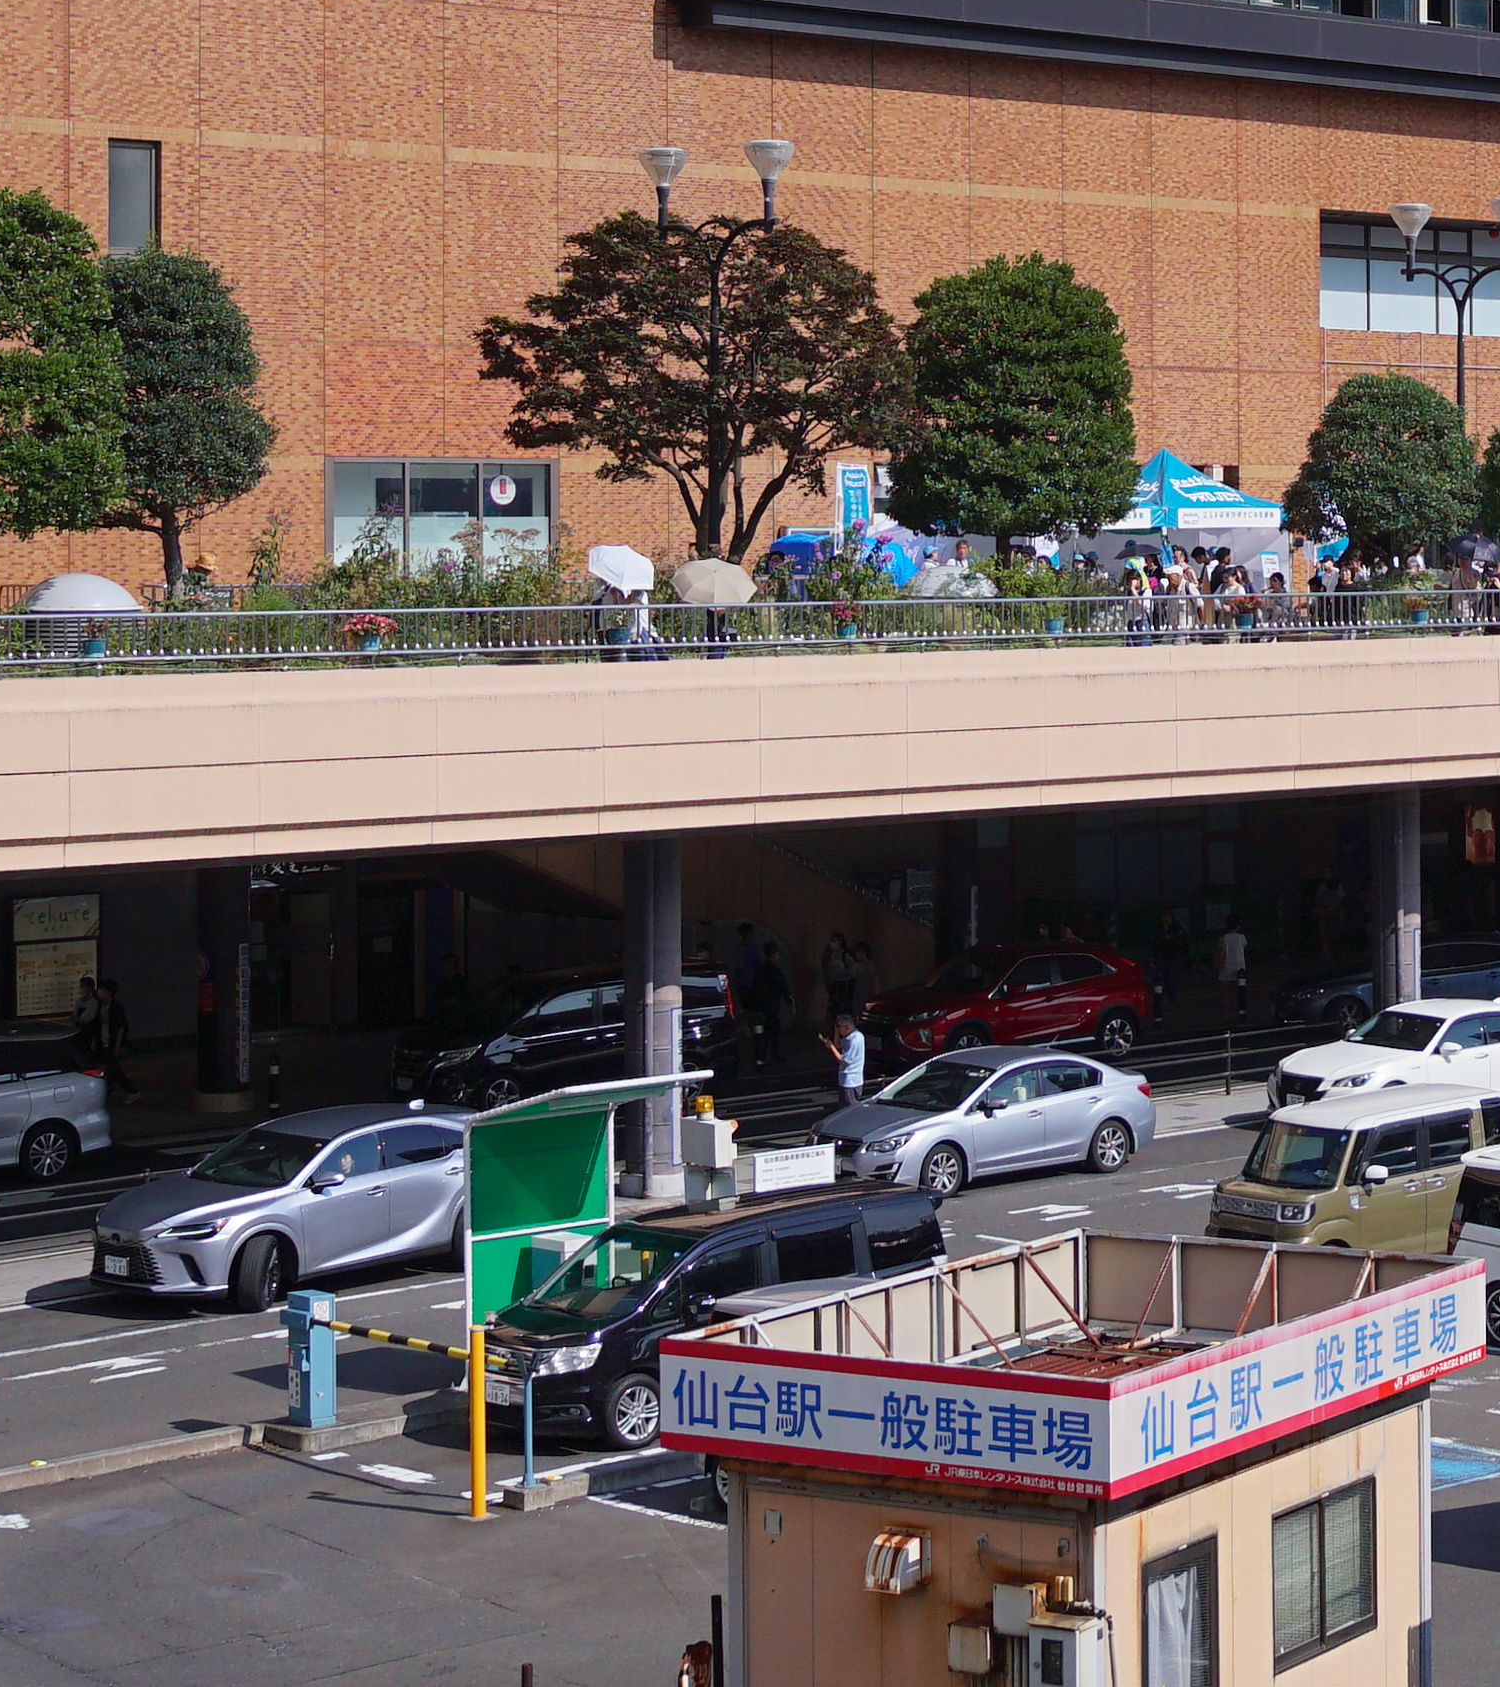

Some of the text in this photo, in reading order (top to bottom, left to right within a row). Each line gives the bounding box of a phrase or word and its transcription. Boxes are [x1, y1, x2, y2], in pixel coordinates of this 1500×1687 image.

[672, 1367, 1094, 1471] 仙台駅一般駐車場
[1140, 1292, 1458, 1464] 仙台駅一般駐車場
[924, 1463, 940, 1475] JR
